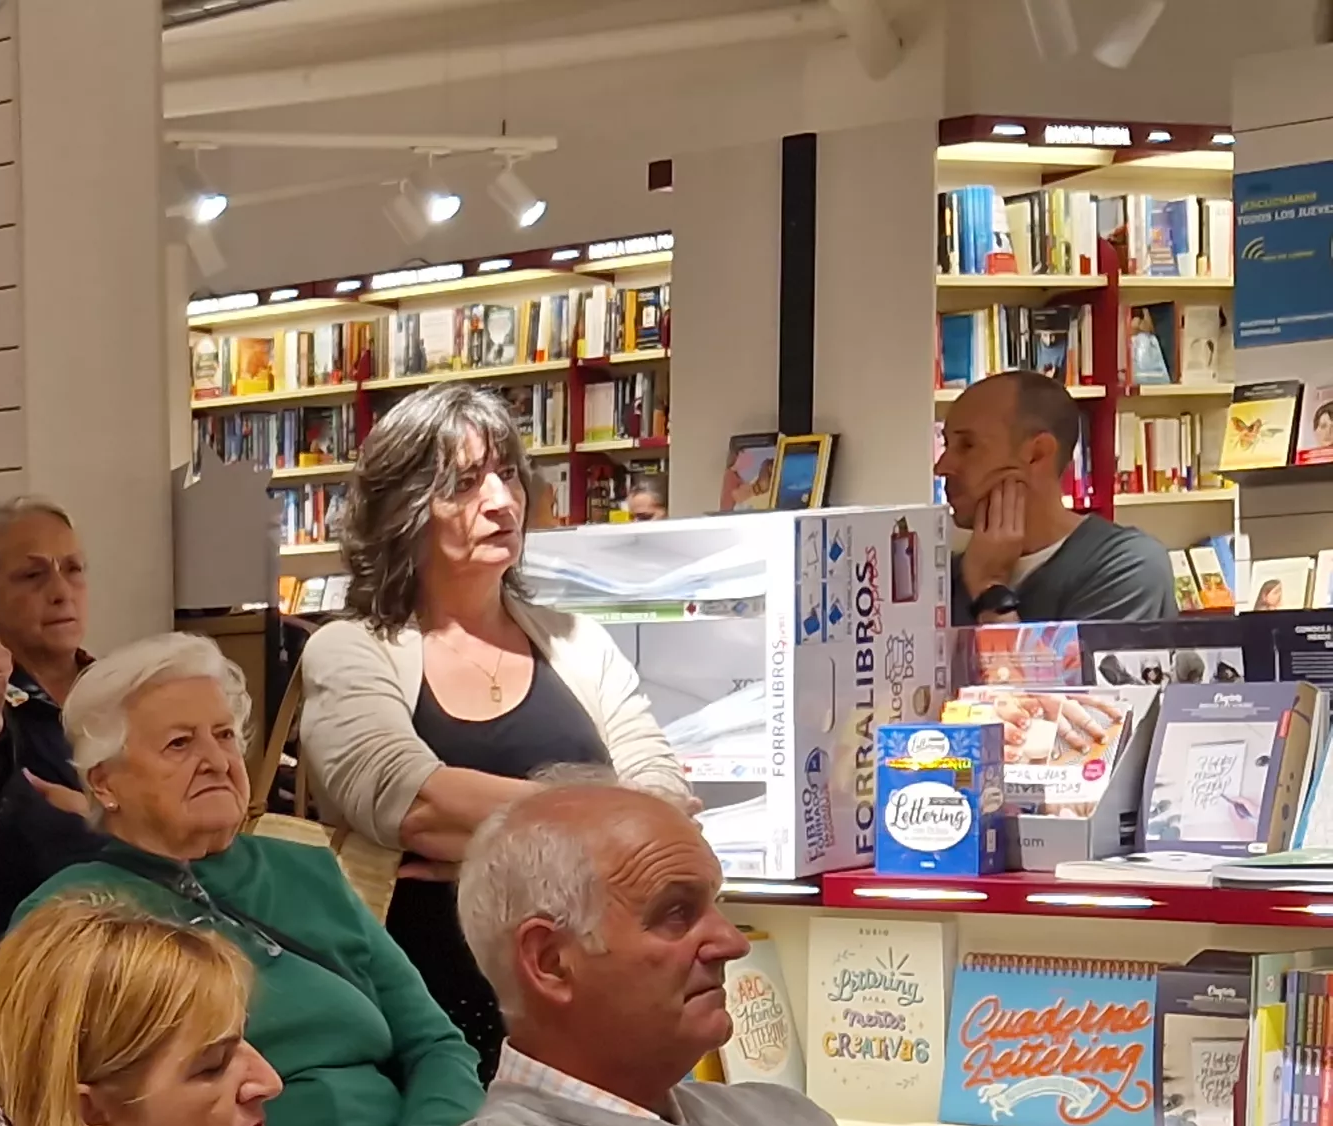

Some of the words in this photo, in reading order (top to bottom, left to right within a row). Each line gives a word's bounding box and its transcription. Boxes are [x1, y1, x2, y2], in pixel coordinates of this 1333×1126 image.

[1275, 208, 1296, 221] LOS
[902, 633, 915, 679] box
[771, 639, 786, 777] FORRALIBROS
[855, 561, 875, 855] FORRALIBROS
[889, 681, 904, 724] ice
[889, 791, 968, 831] Lettering
[736, 975, 765, 1003] ABC
[828, 967, 924, 1007] Lettering
[843, 1008, 907, 1031] mentes
[959, 994, 1153, 1049] Cuaderno
[962, 1037, 1153, 1110] Lettering
